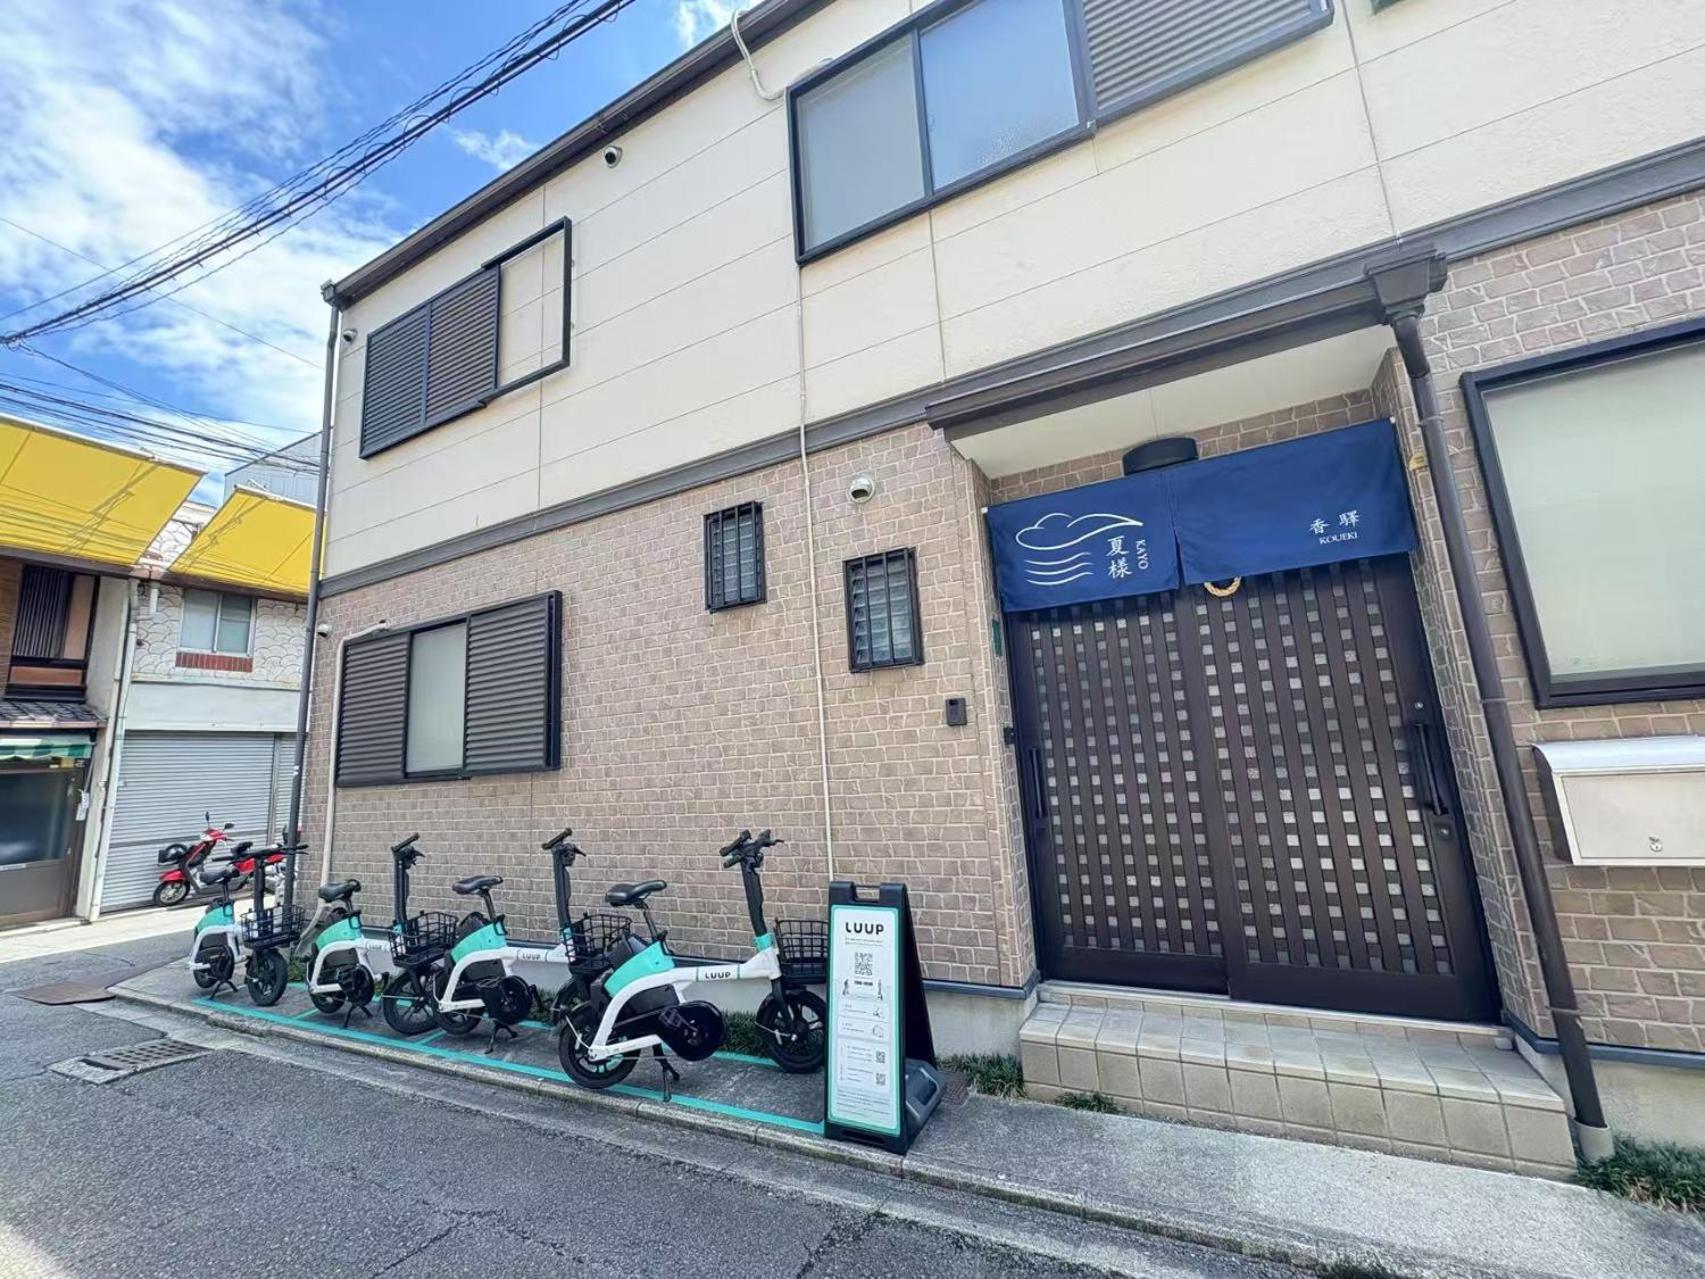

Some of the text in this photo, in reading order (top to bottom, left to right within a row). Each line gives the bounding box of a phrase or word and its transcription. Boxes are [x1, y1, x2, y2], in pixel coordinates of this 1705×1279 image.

[1319, 531, 1358, 545] KOUEKI
[1106, 534, 1134, 579] 夏様
[1136, 539, 1149, 570] KAYO
[844, 921, 885, 936] LUUP
[522, 952, 541, 960] LUUP
[705, 971, 732, 979] LUUP
